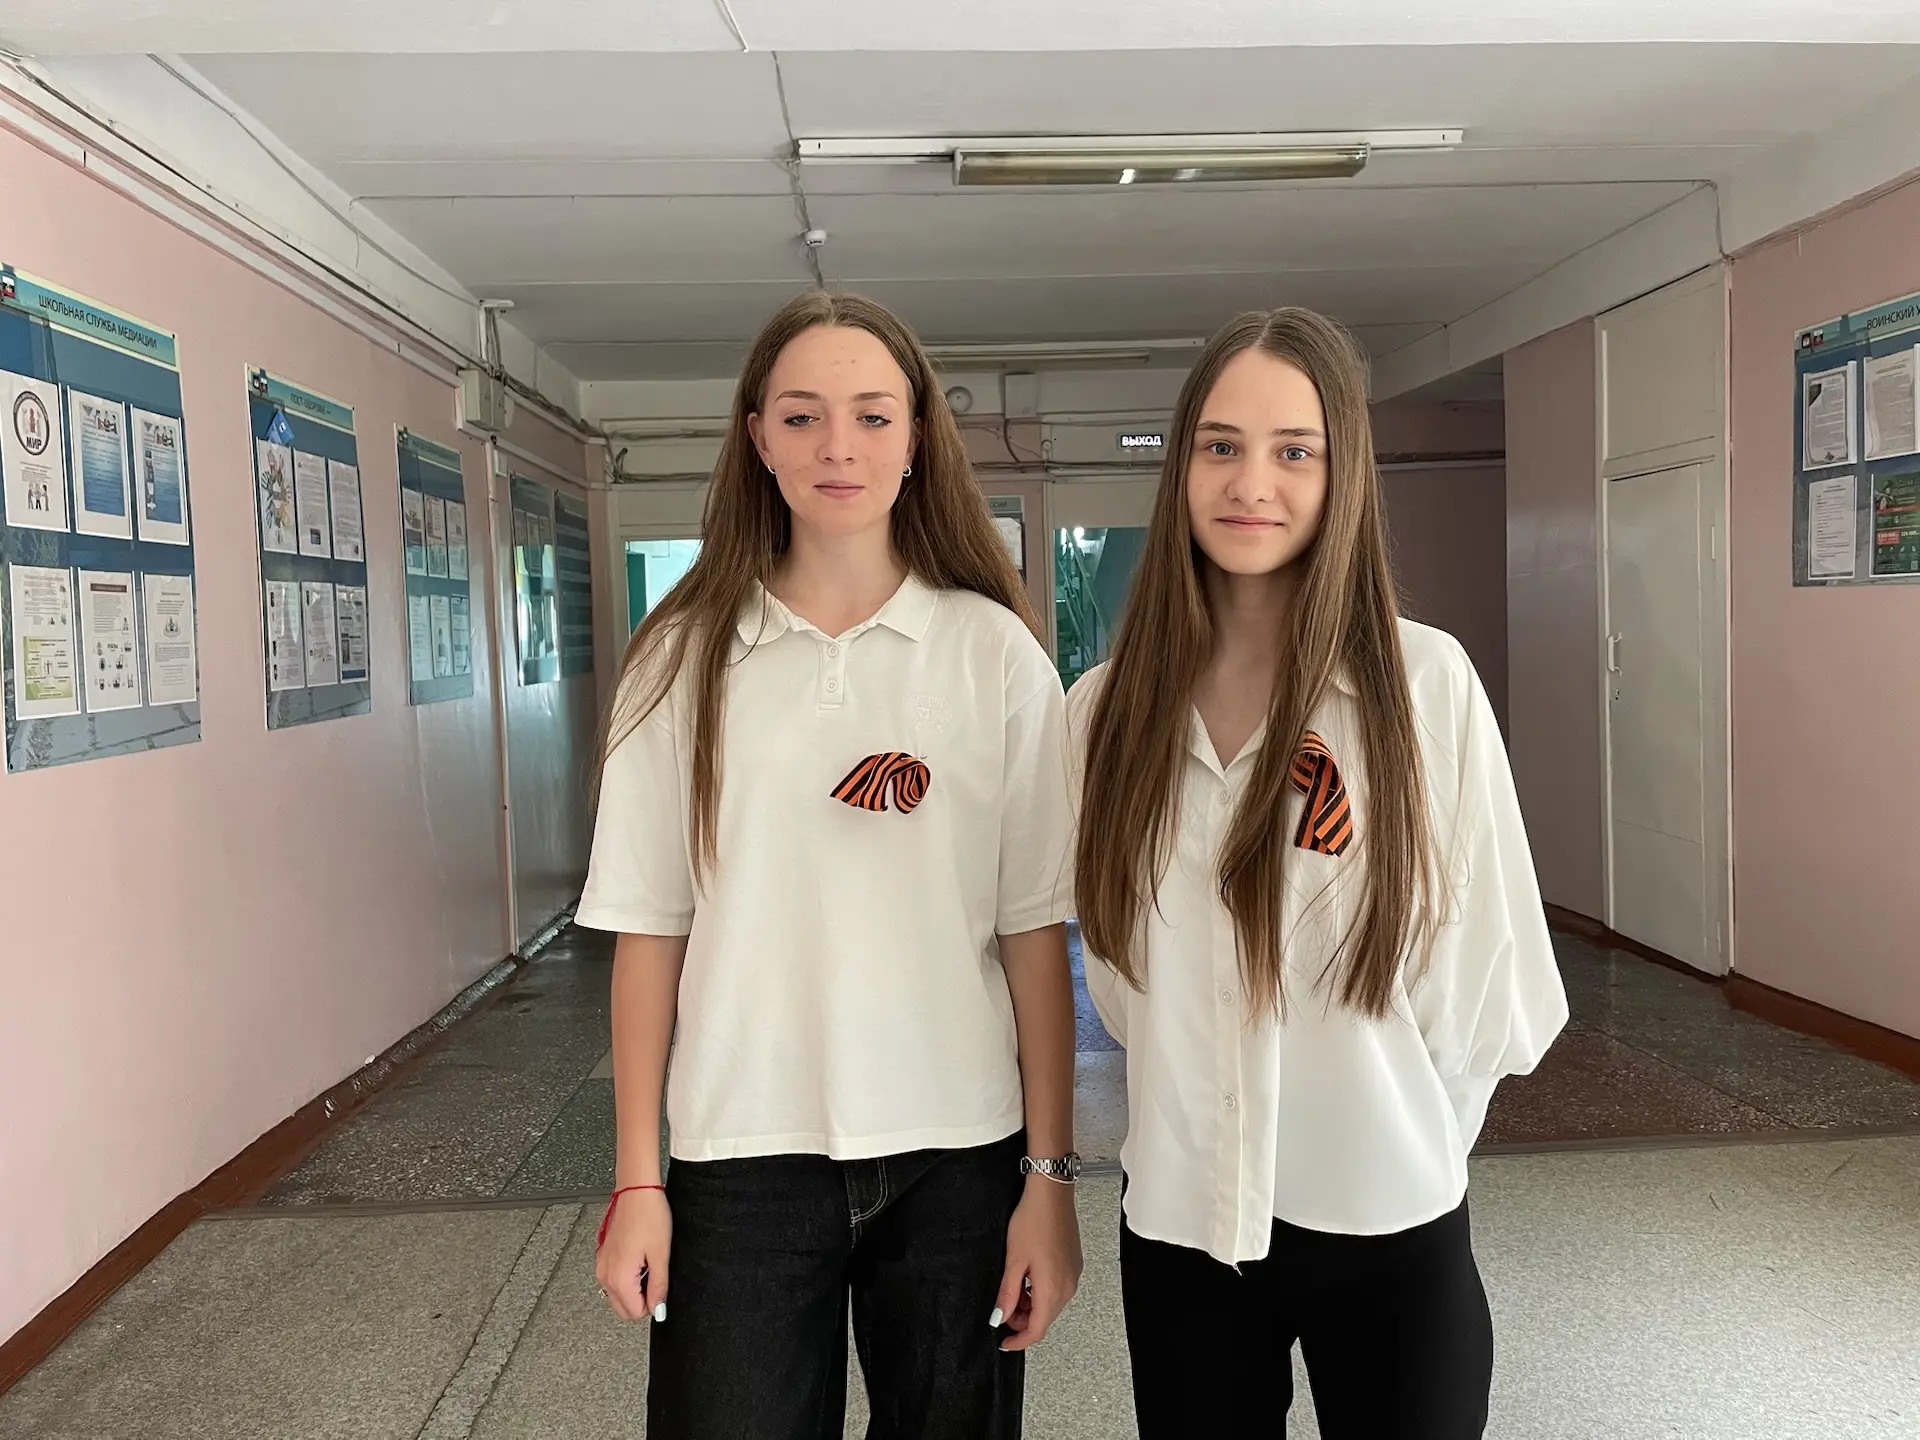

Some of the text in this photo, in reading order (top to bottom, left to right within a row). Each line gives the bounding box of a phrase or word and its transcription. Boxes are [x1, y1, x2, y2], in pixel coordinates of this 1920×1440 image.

[38, 294, 157, 349] ШКОЛЬНАЯ СЛУЖБА МЕДИАЦИИ
[1866, 304, 1914, 330] ВОИНСКИЙ
[26, 436, 42, 450] МИР
[1121, 435, 1163, 447] ВЫХОД
